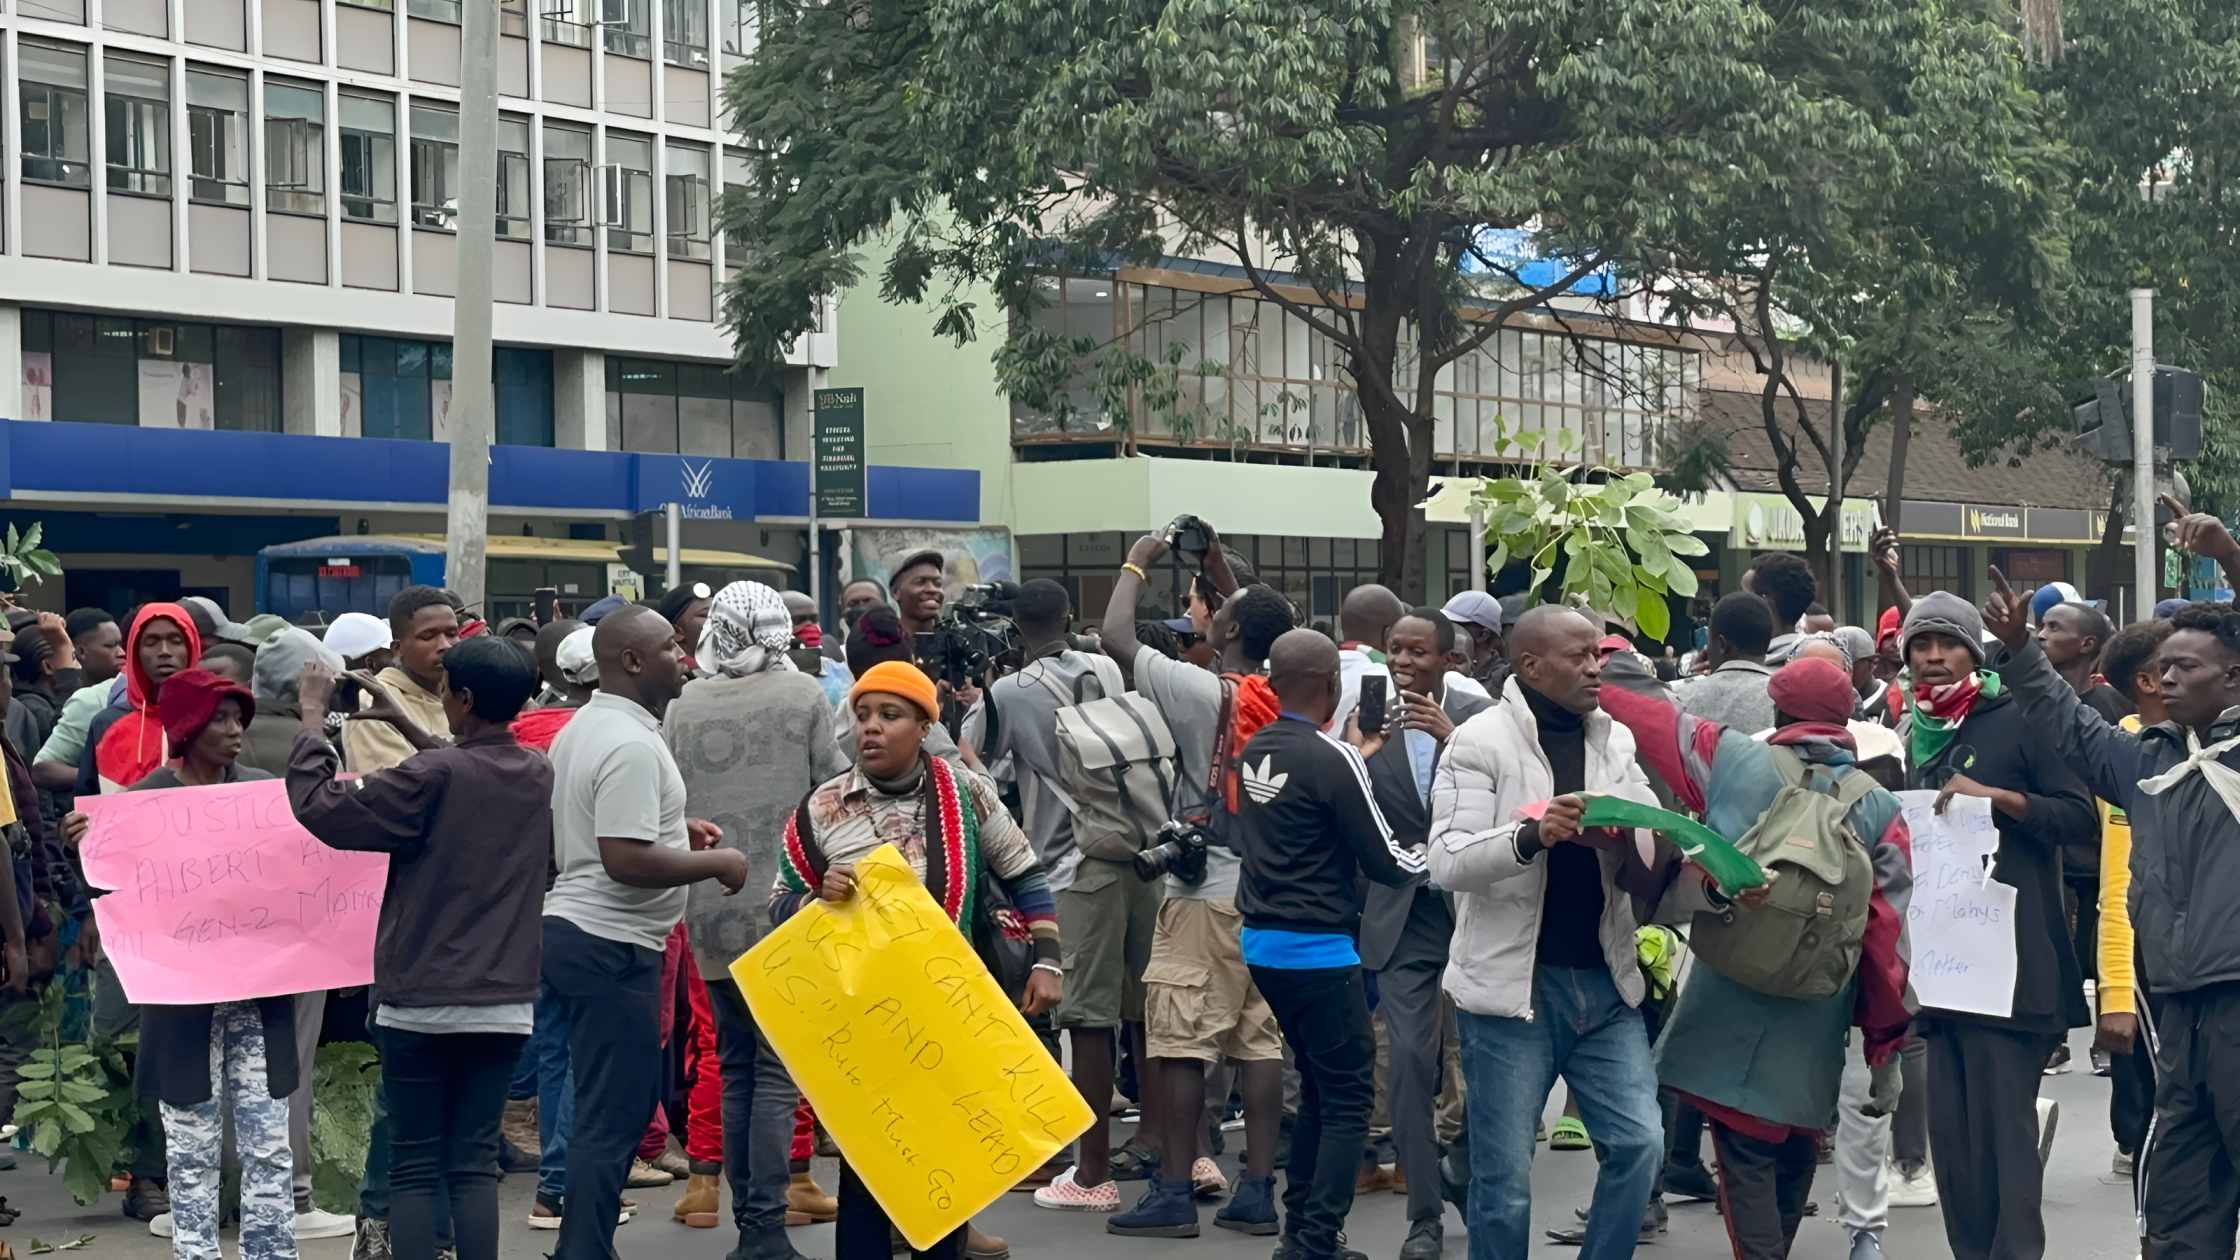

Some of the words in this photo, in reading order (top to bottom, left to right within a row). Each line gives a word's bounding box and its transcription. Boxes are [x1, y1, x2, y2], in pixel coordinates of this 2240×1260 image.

[806, 912, 862, 972] US
[866, 997, 944, 1070] AND
[952, 1091, 1021, 1175] LEAD
[924, 956, 1018, 1039] CANT
[1002, 1055, 1066, 1144] KILL
